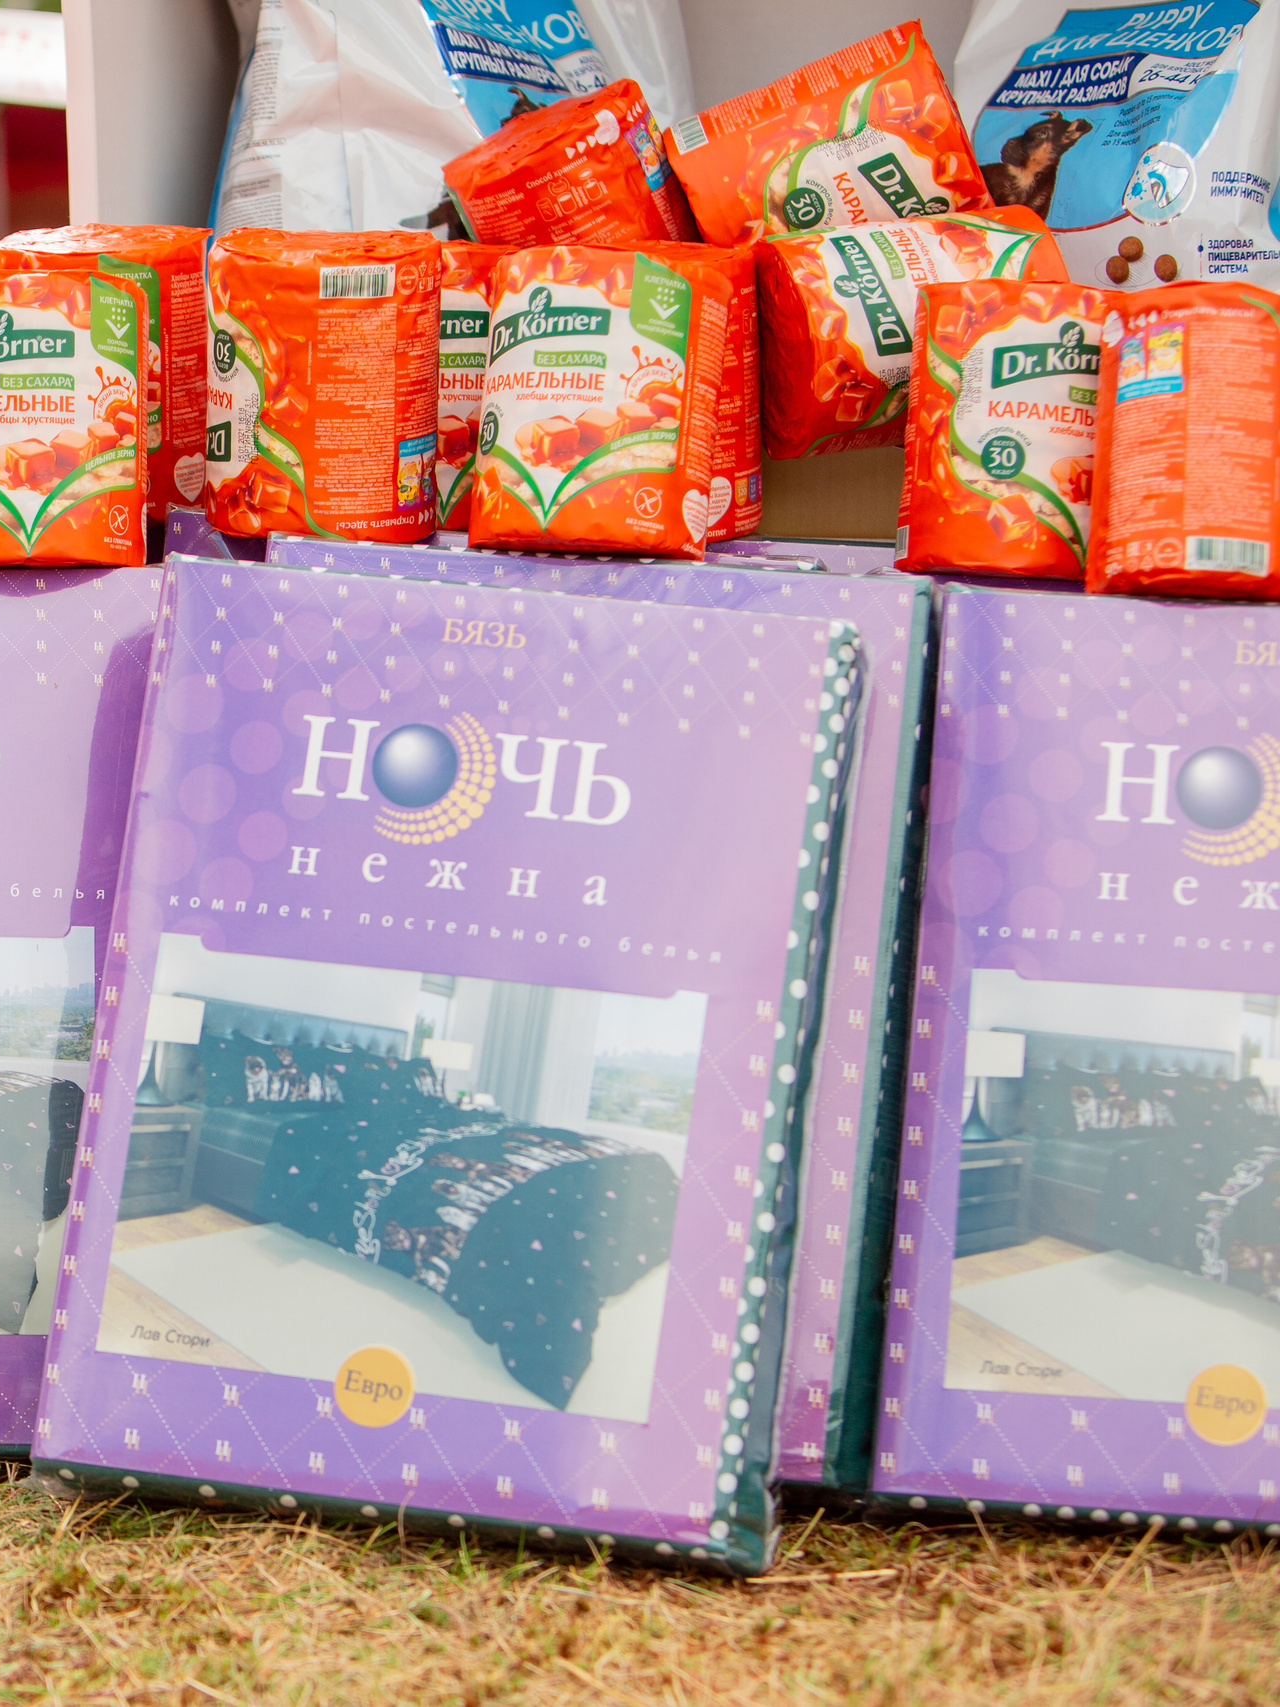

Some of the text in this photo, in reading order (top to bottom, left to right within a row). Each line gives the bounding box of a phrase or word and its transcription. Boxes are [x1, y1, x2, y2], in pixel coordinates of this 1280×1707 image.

[1120, 2, 1214, 31] PUPPY
[1033, 23, 1243, 62] ДЛЯ ЩЕНКОВ
[448, 51, 509, 75] КРУПНЫХ
[1014, 69, 1051, 88] MAXI
[1059, 65, 1090, 87] ДЛЯ
[1091, 55, 1133, 80] СОБАК
[1138, 69, 1191, 84] 26-44
[996, 76, 1128, 105] КРУПНЫХ РАЗМЕРОВ
[870, 163, 905, 201] Dr.
[790, 192, 817, 222] 30
[1208, 239, 1254, 250] ЗДОРОВАЯ
[839, 239, 888, 306] Körner
[1208, 264, 1249, 274] СИСТЕМА
[644, 274, 687, 291] КЛЕТЧАТКА
[99, 295, 134, 309] КЛЕТЧАТКА
[493, 310, 602, 356] Dr. Körner
[877, 307, 906, 346] Dr.
[216, 341, 232, 363] 30
[537, 353, 557, 365] БЕЗ
[1002, 352, 1042, 380] Dr.
[2, 377, 24, 388] БЕЗ
[111, 388, 126, 399] ВКУС
[486, 371, 606, 394] КАРАМЕЛЬНЫЕ
[516, 392, 603, 403] хлебцы хрустящие
[1072, 390, 1090, 403] БЕЗ
[21, 416, 75, 426] хрустящие
[988, 401, 1095, 426] КАРАМЕЛЬ
[482, 421, 495, 439] 30
[610, 430, 677, 451] ЦЕЛЬНОЕ ЗЕРНО
[85, 447, 135, 471] ЦЕЛЬНОЕ ЗЕРНО
[988, 447, 1018, 468] 30
[336, 514, 415, 531] Открывать здесь!
[441, 616, 528, 650] БЯЗЬ
[287, 844, 608, 907] нежна
[11, 883, 107, 900] белья
[168, 892, 723, 964] комплект постельного белья
[977, 924, 1148, 946] комплект
[129, 1324, 211, 1351] Лав Стори
[342, 1369, 405, 1404] Евро
[1194, 1384, 1259, 1418] Евро
